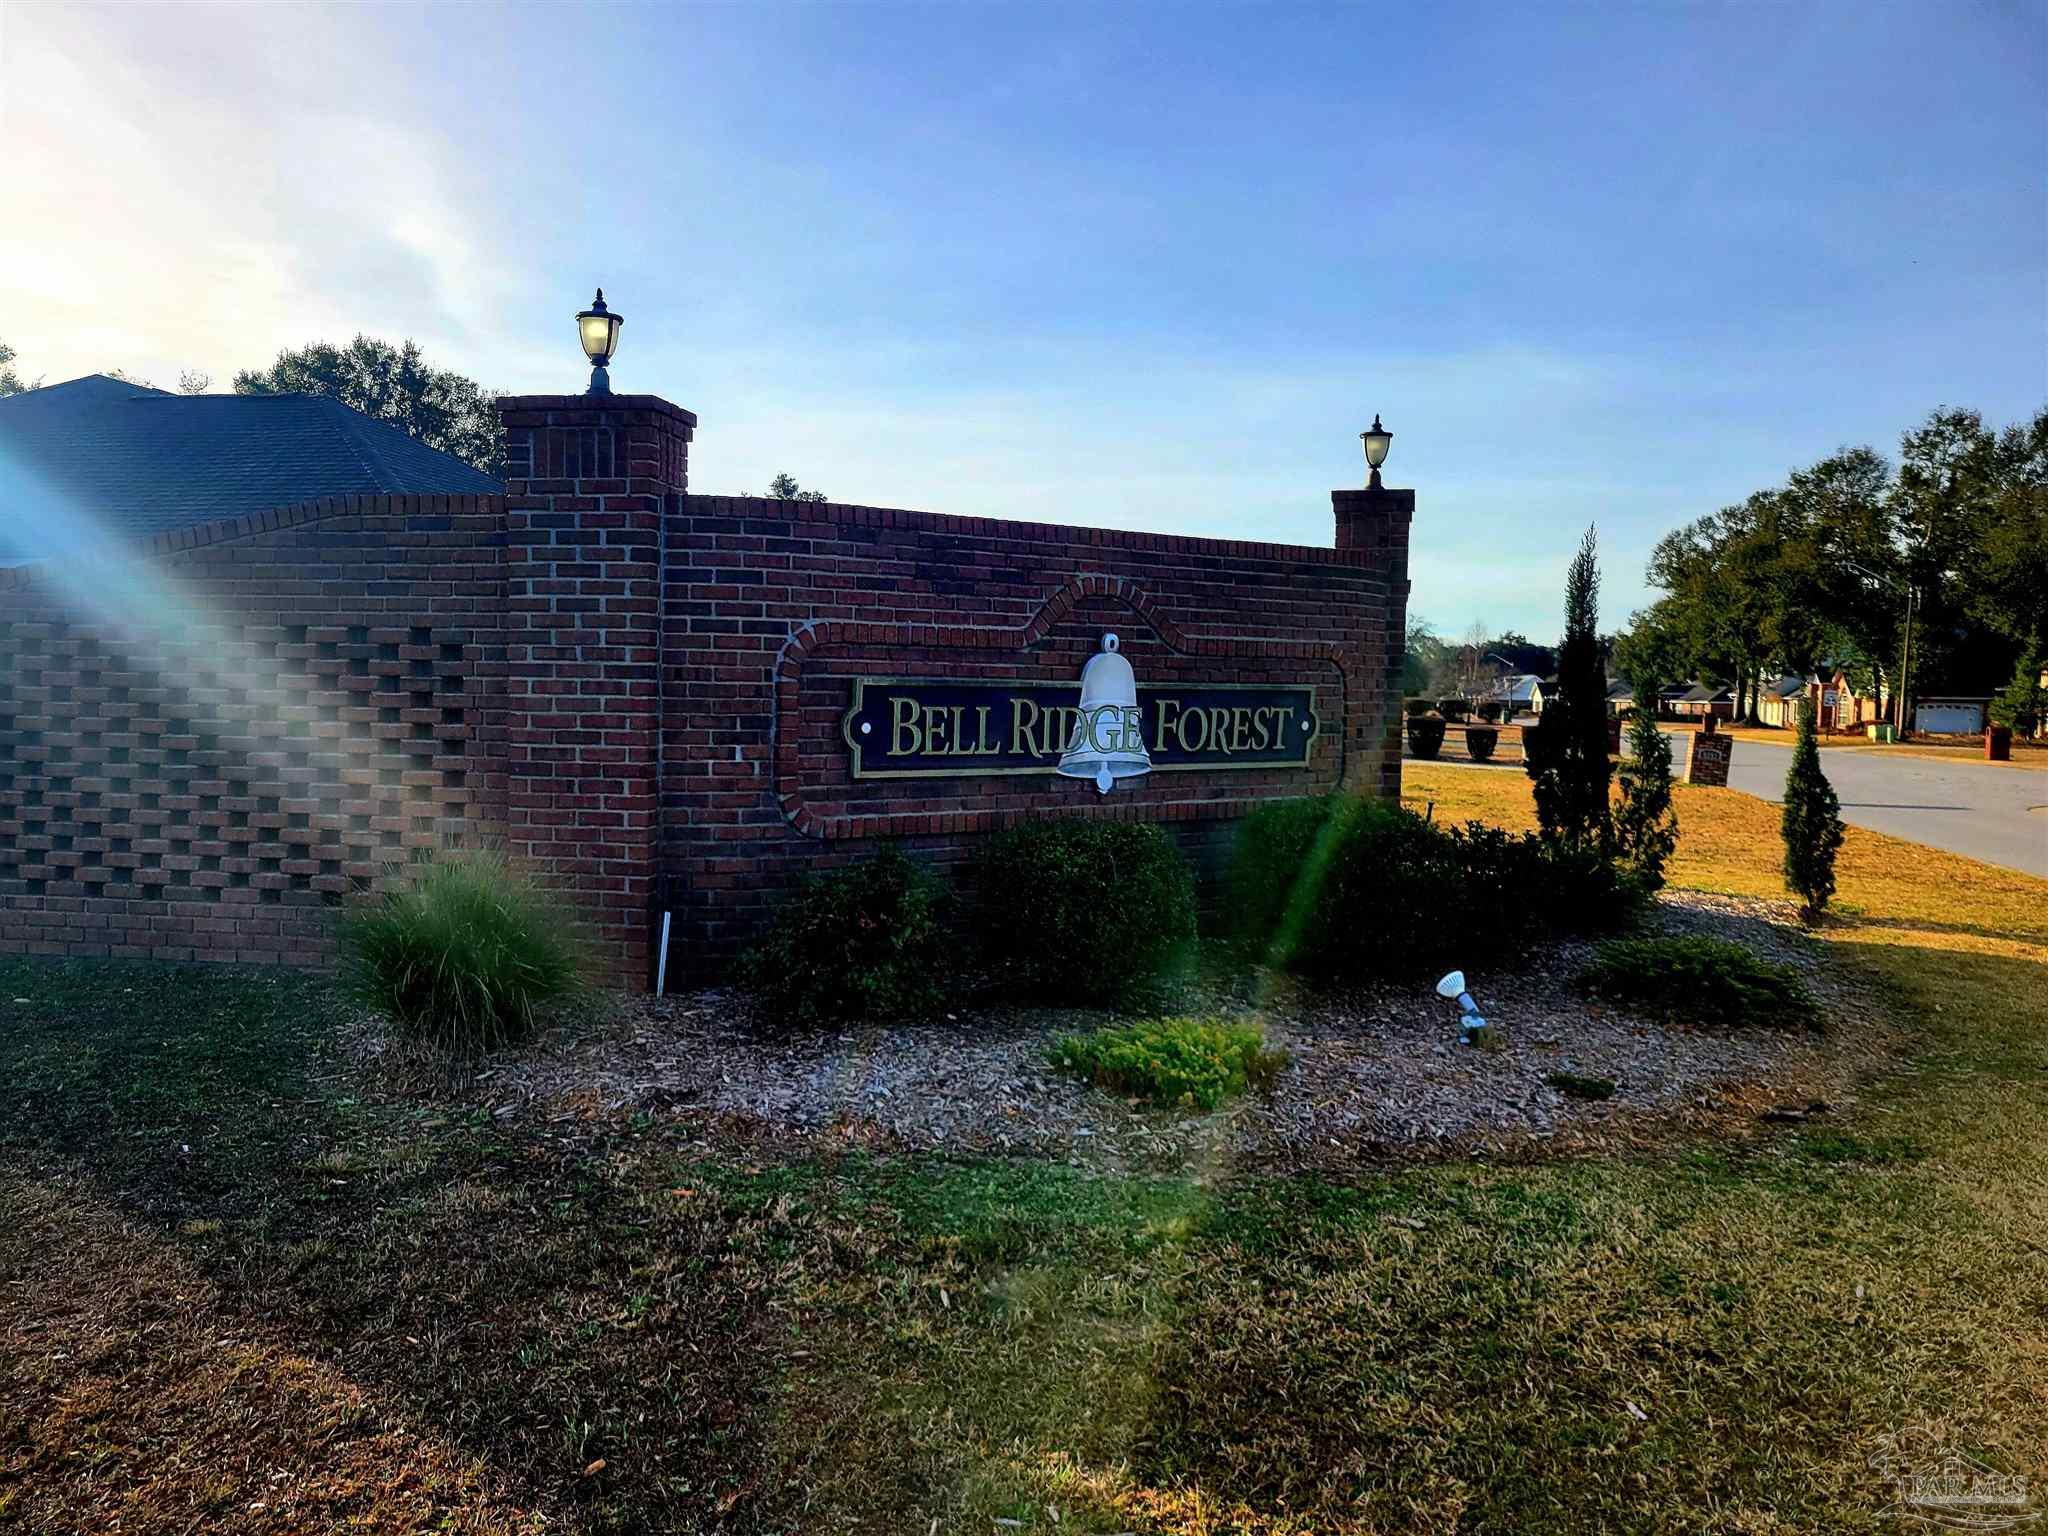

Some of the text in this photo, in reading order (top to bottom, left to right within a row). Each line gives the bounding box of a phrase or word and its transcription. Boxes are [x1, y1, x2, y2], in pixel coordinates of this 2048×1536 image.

[886, 697, 1294, 759] BELL RIDGE FOREST
